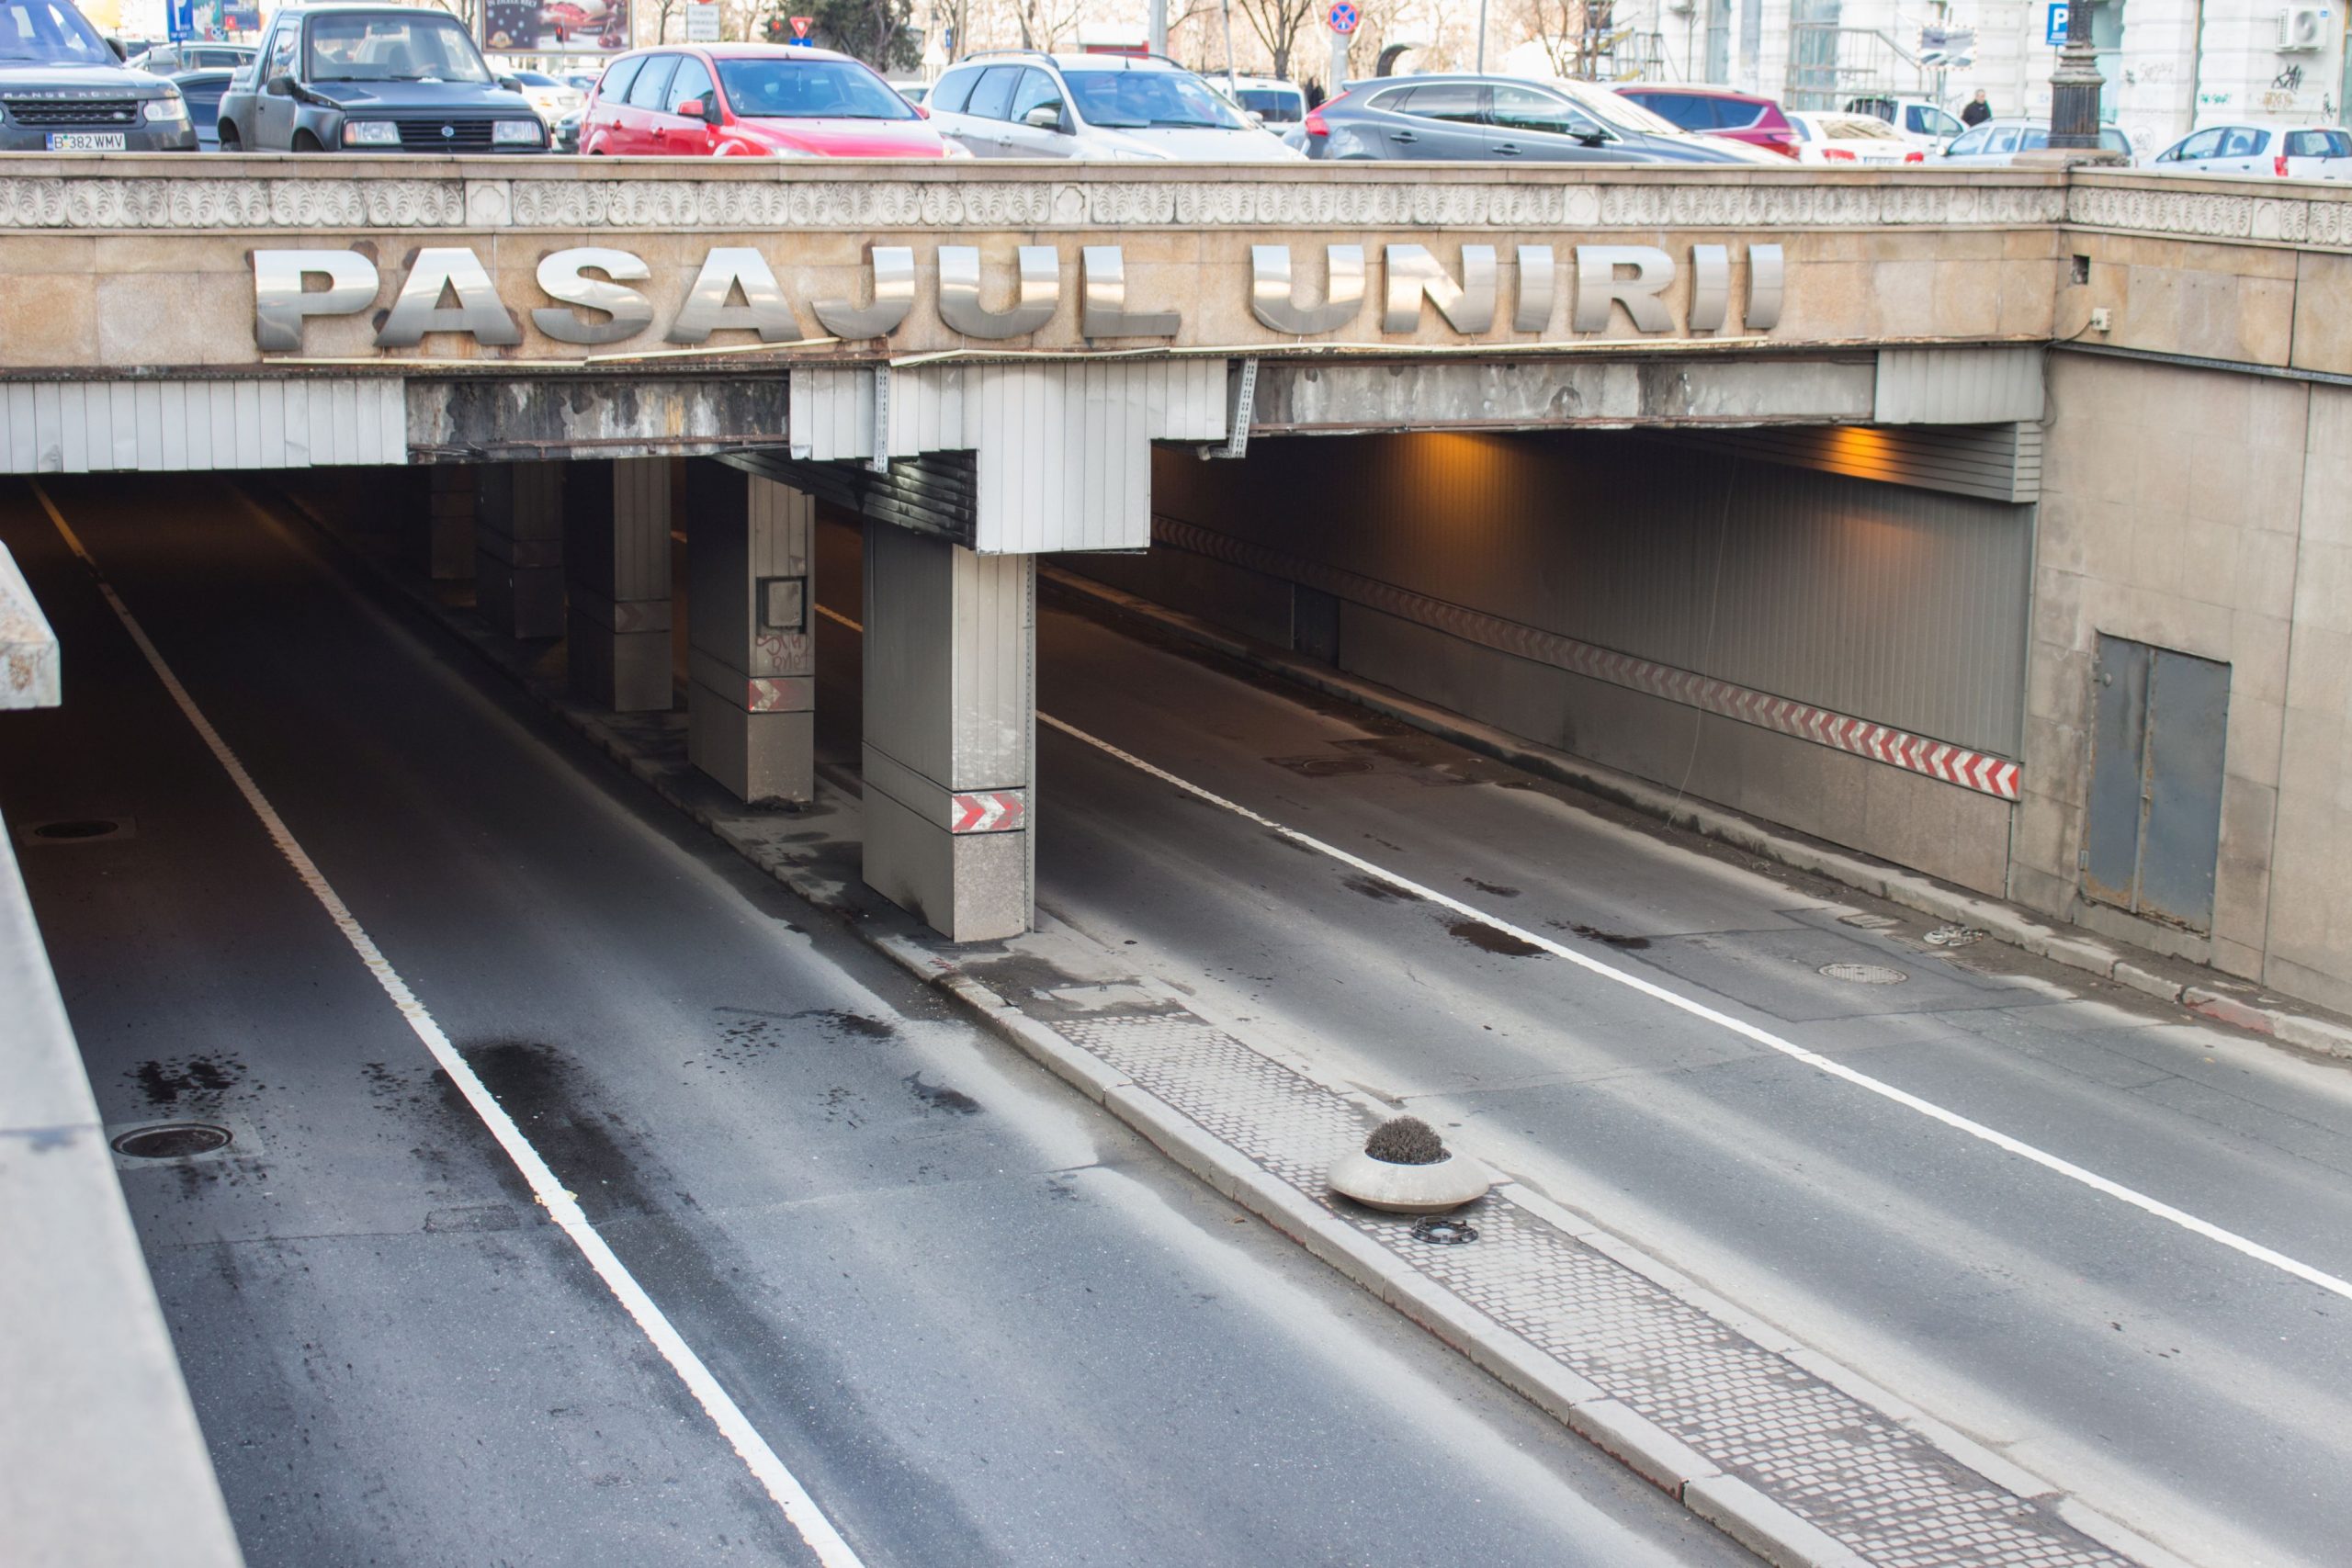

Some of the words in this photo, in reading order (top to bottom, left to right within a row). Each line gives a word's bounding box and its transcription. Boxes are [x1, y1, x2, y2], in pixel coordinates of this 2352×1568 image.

[2052, 7, 2069, 31] P
[54, 136, 63, 148] B
[69, 136, 92, 148] 382
[94, 135, 123, 148] WMV
[254, 245, 1182, 351] PASAJUL
[1250, 243, 1784, 334] UNIRII
